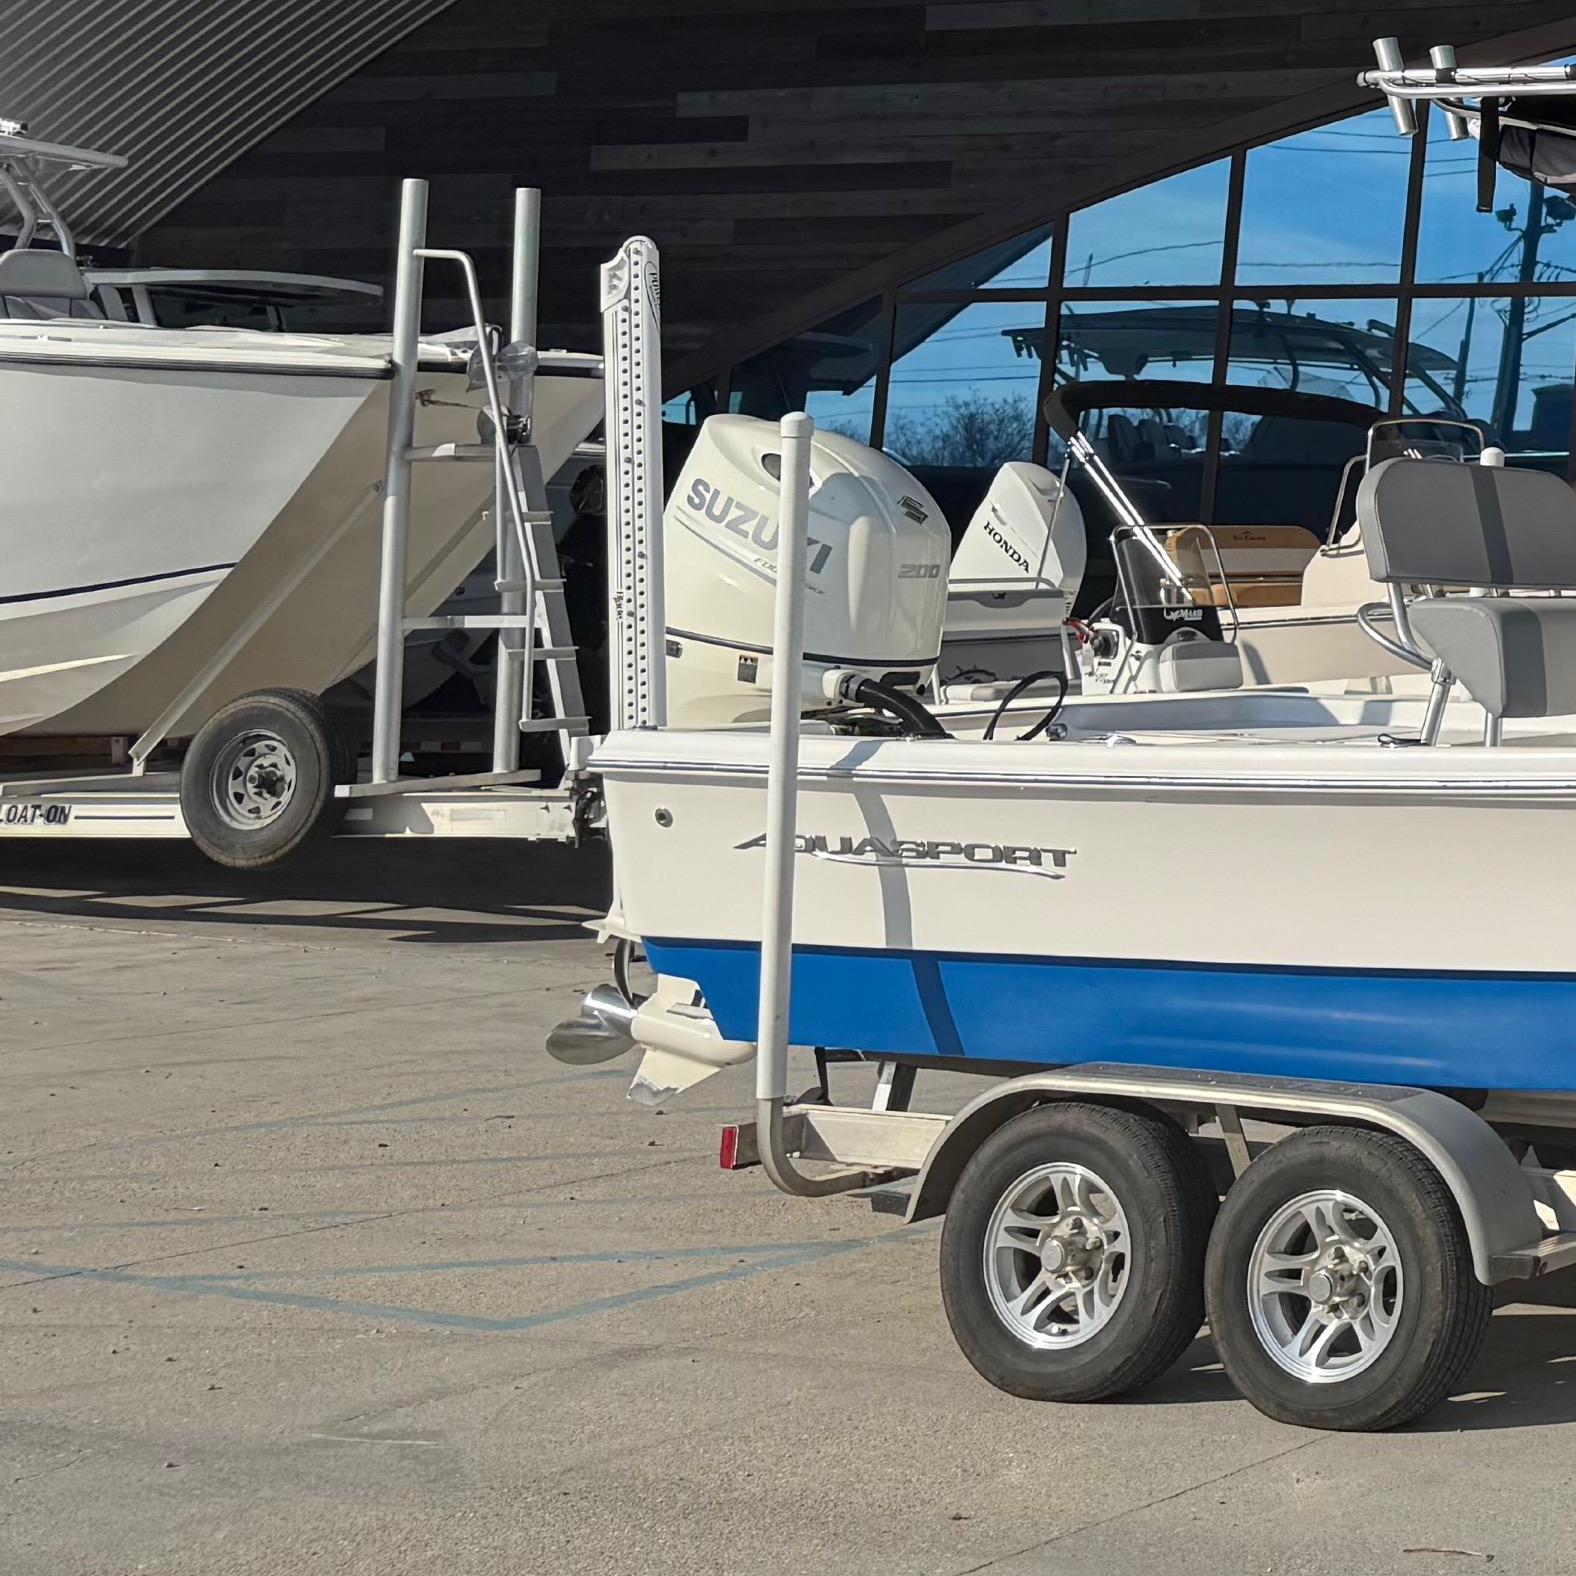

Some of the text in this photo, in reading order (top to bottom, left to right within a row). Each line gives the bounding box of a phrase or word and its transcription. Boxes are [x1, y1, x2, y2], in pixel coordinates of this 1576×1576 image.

[686, 478, 833, 574] SUZUI
[983, 521, 1030, 574] HONDA
[897, 563, 941, 579] 200
[0, 804, 72, 824] OAT-ON
